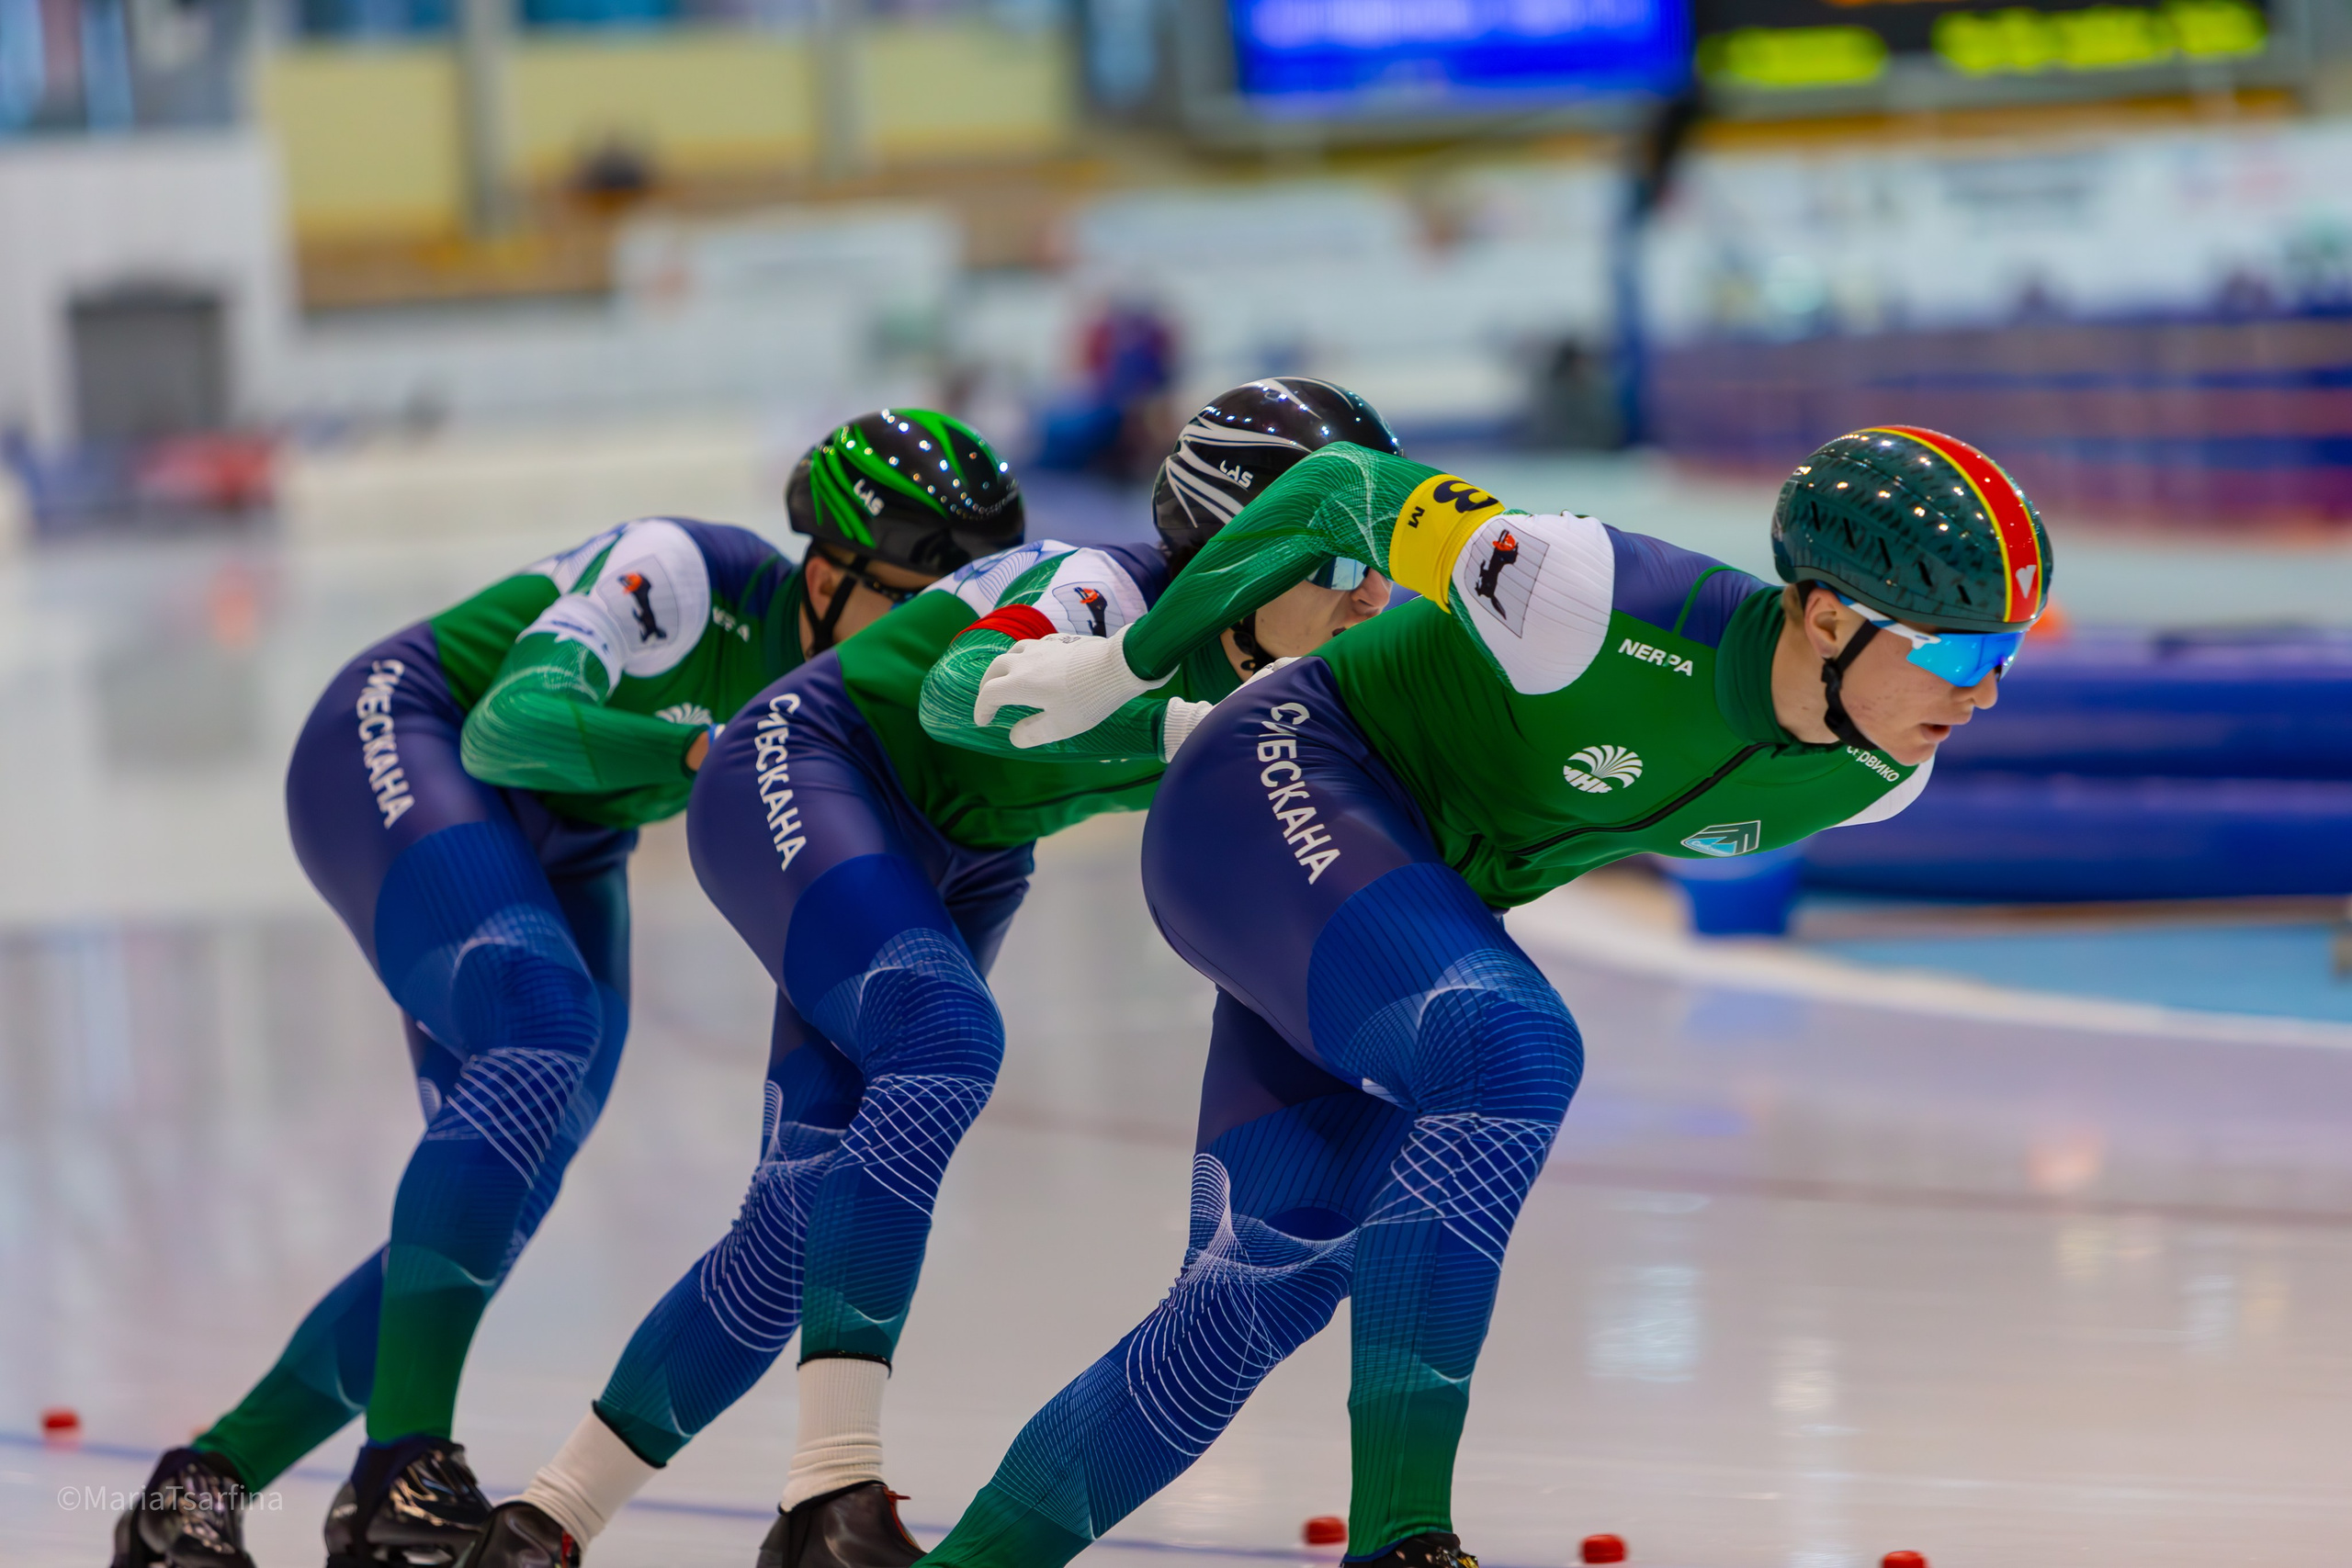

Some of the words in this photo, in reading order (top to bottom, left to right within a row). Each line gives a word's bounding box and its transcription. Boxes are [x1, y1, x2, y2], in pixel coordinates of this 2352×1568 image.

[1219, 459, 1253, 489] LAS
[1618, 637, 1693, 677] NERPA
[1257, 702, 1340, 886] СИБСКАНА
